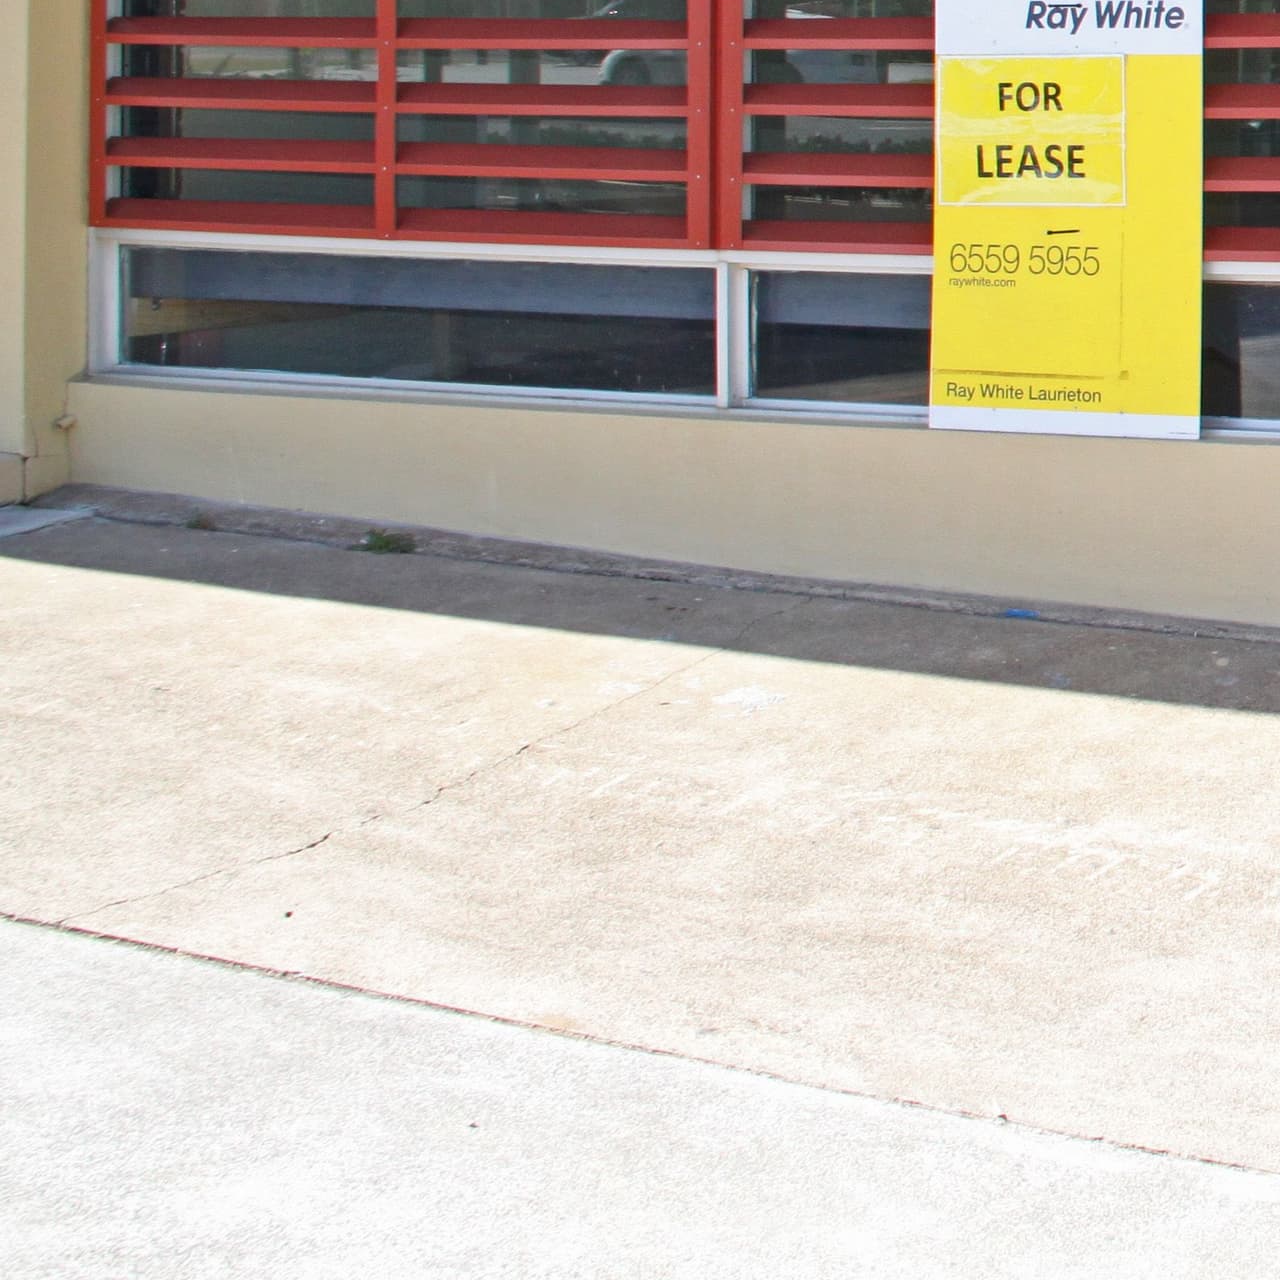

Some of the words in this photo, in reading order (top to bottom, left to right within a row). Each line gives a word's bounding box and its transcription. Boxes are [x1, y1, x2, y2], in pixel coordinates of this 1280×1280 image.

[1025, 0, 1088, 35] Ray
[1095, 0, 1185, 29] White
[998, 82, 1063, 111] FOR
[977, 144, 1086, 178] LEASE
[950, 243, 1020, 274] 6559
[1028, 245, 1100, 276] 5955
[949, 276, 1017, 289] raywhite.com
[946, 381, 976, 401] Ray
[980, 383, 1024, 400] White
[1028, 384, 1102, 403] Laurieton
